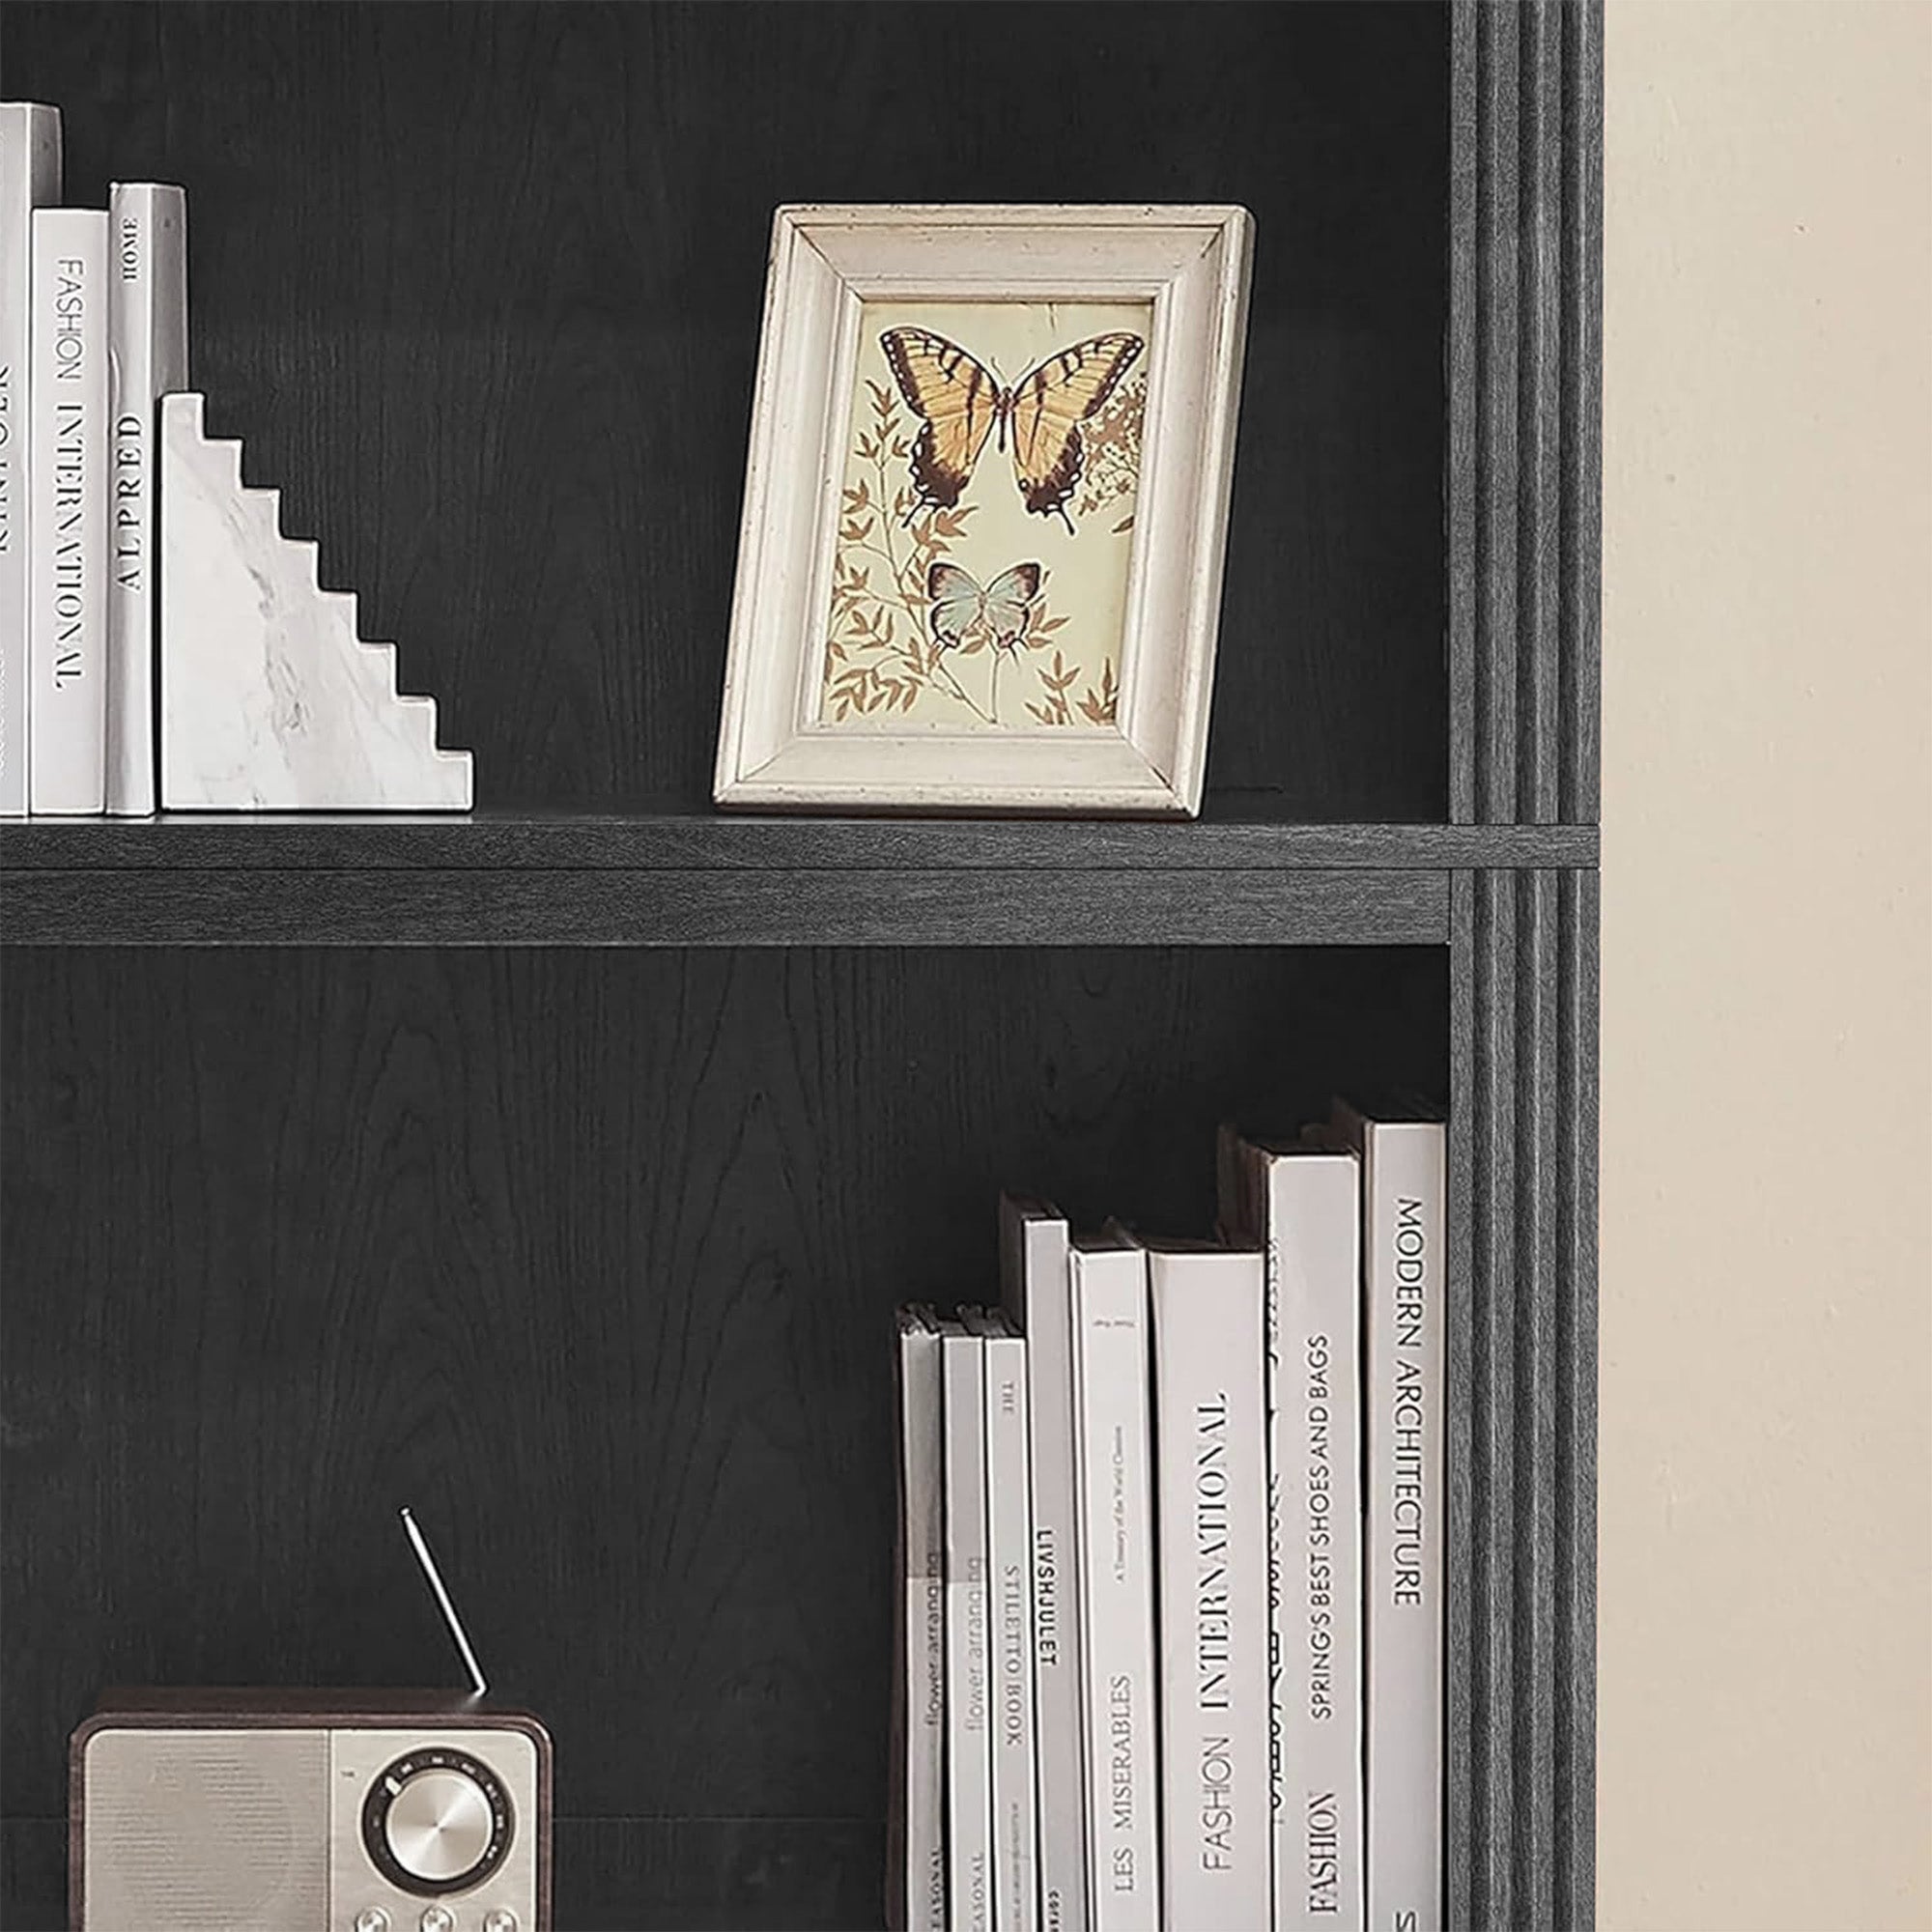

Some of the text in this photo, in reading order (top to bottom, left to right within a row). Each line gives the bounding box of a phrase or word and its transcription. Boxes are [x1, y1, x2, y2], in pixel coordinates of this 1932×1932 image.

[123, 217, 138, 280] HOME
[56, 259, 83, 690] FASHION INTERNATIONAL
[117, 415, 141, 590] ALPRED
[1307, 1335, 1329, 1399] BAGS
[1393, 1199, 1424, 1605] MODERN ARCHITECTURE
[1308, 1406, 1329, 1460] AND
[1309, 1464, 1330, 1548] SHOES
[1037, 1530, 1057, 1666] LIVSHJULET
[1197, 1393, 1233, 1870] FASHION INTERNATIONAL
[1310, 1553, 1331, 1607] BEST
[924, 1662, 942, 1726] flower
[967, 1667, 983, 1731] flower
[1004, 1565, 1023, 1746] STILETTO BOOK
[1111, 1675, 1134, 1892] LES MISERABLES
[1308, 1790, 1338, 1915] FASHION
